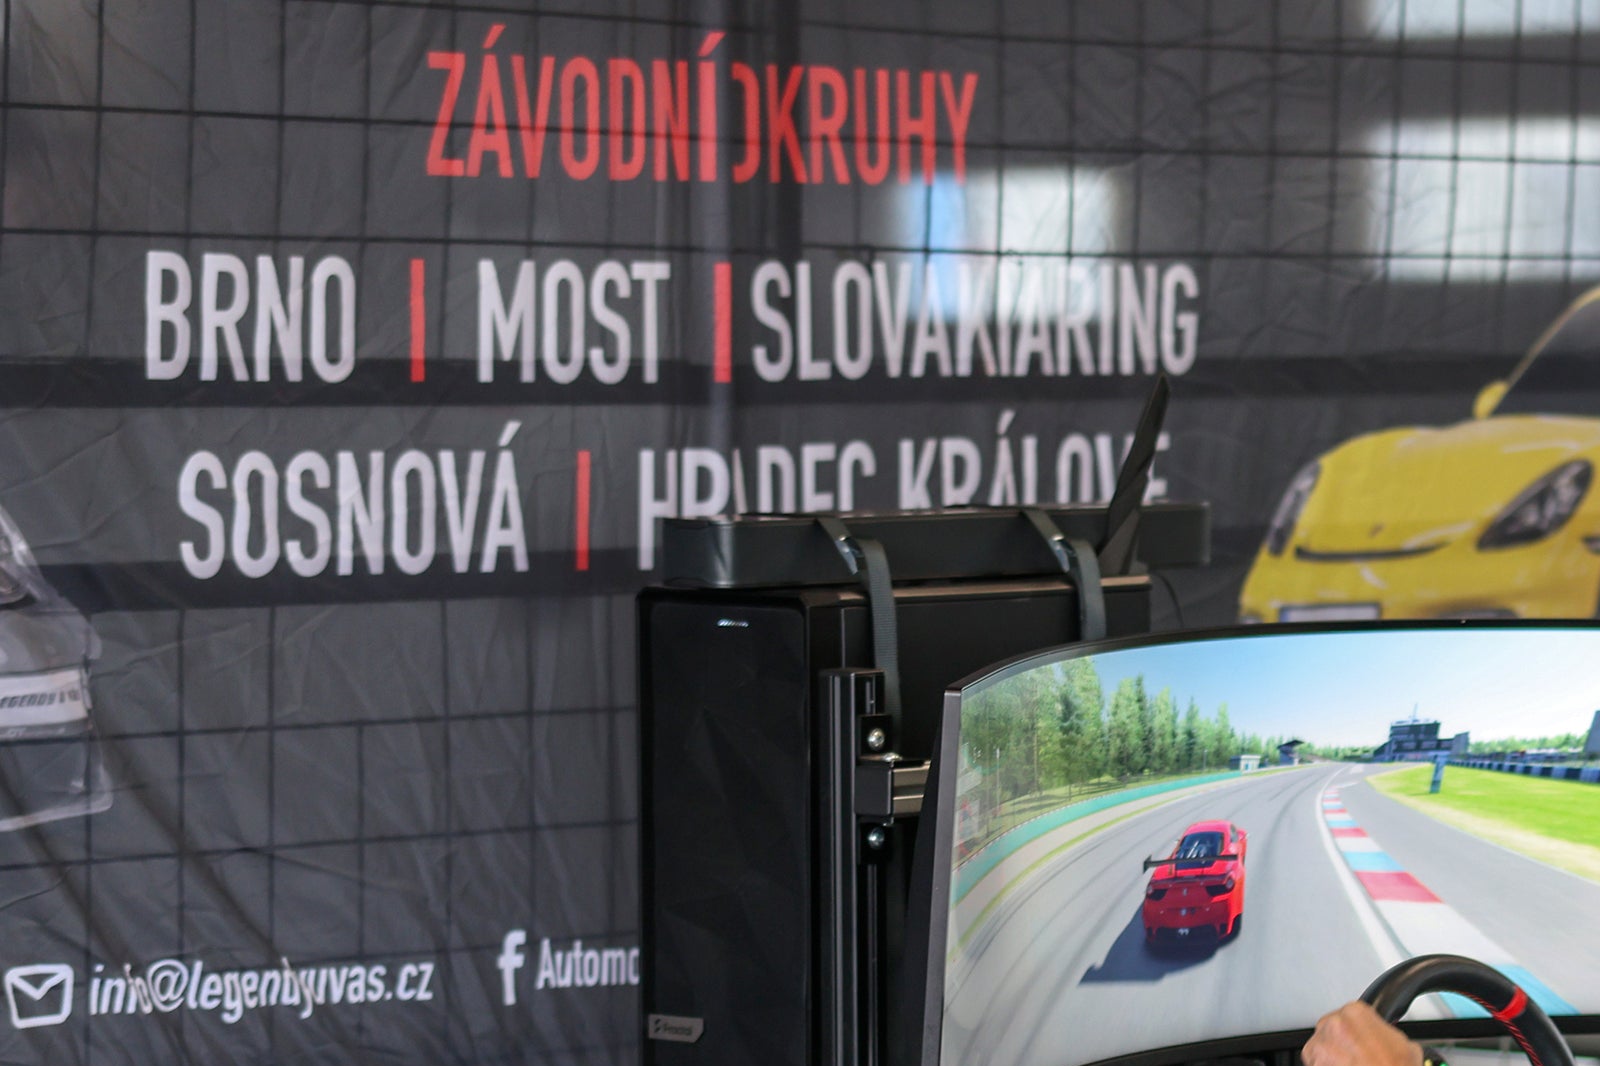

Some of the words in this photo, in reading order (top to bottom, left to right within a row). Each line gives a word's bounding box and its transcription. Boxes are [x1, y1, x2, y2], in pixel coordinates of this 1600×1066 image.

[426, 24, 726, 183] ZÁVODNÍ
[146, 250, 357, 383] BRNO
[478, 259, 671, 385] MOST
[751, 260, 1199, 383] SLOVAKIARING
[179, 421, 530, 580] SOSNOVÁ
[637, 440, 876, 571] HRDEC
